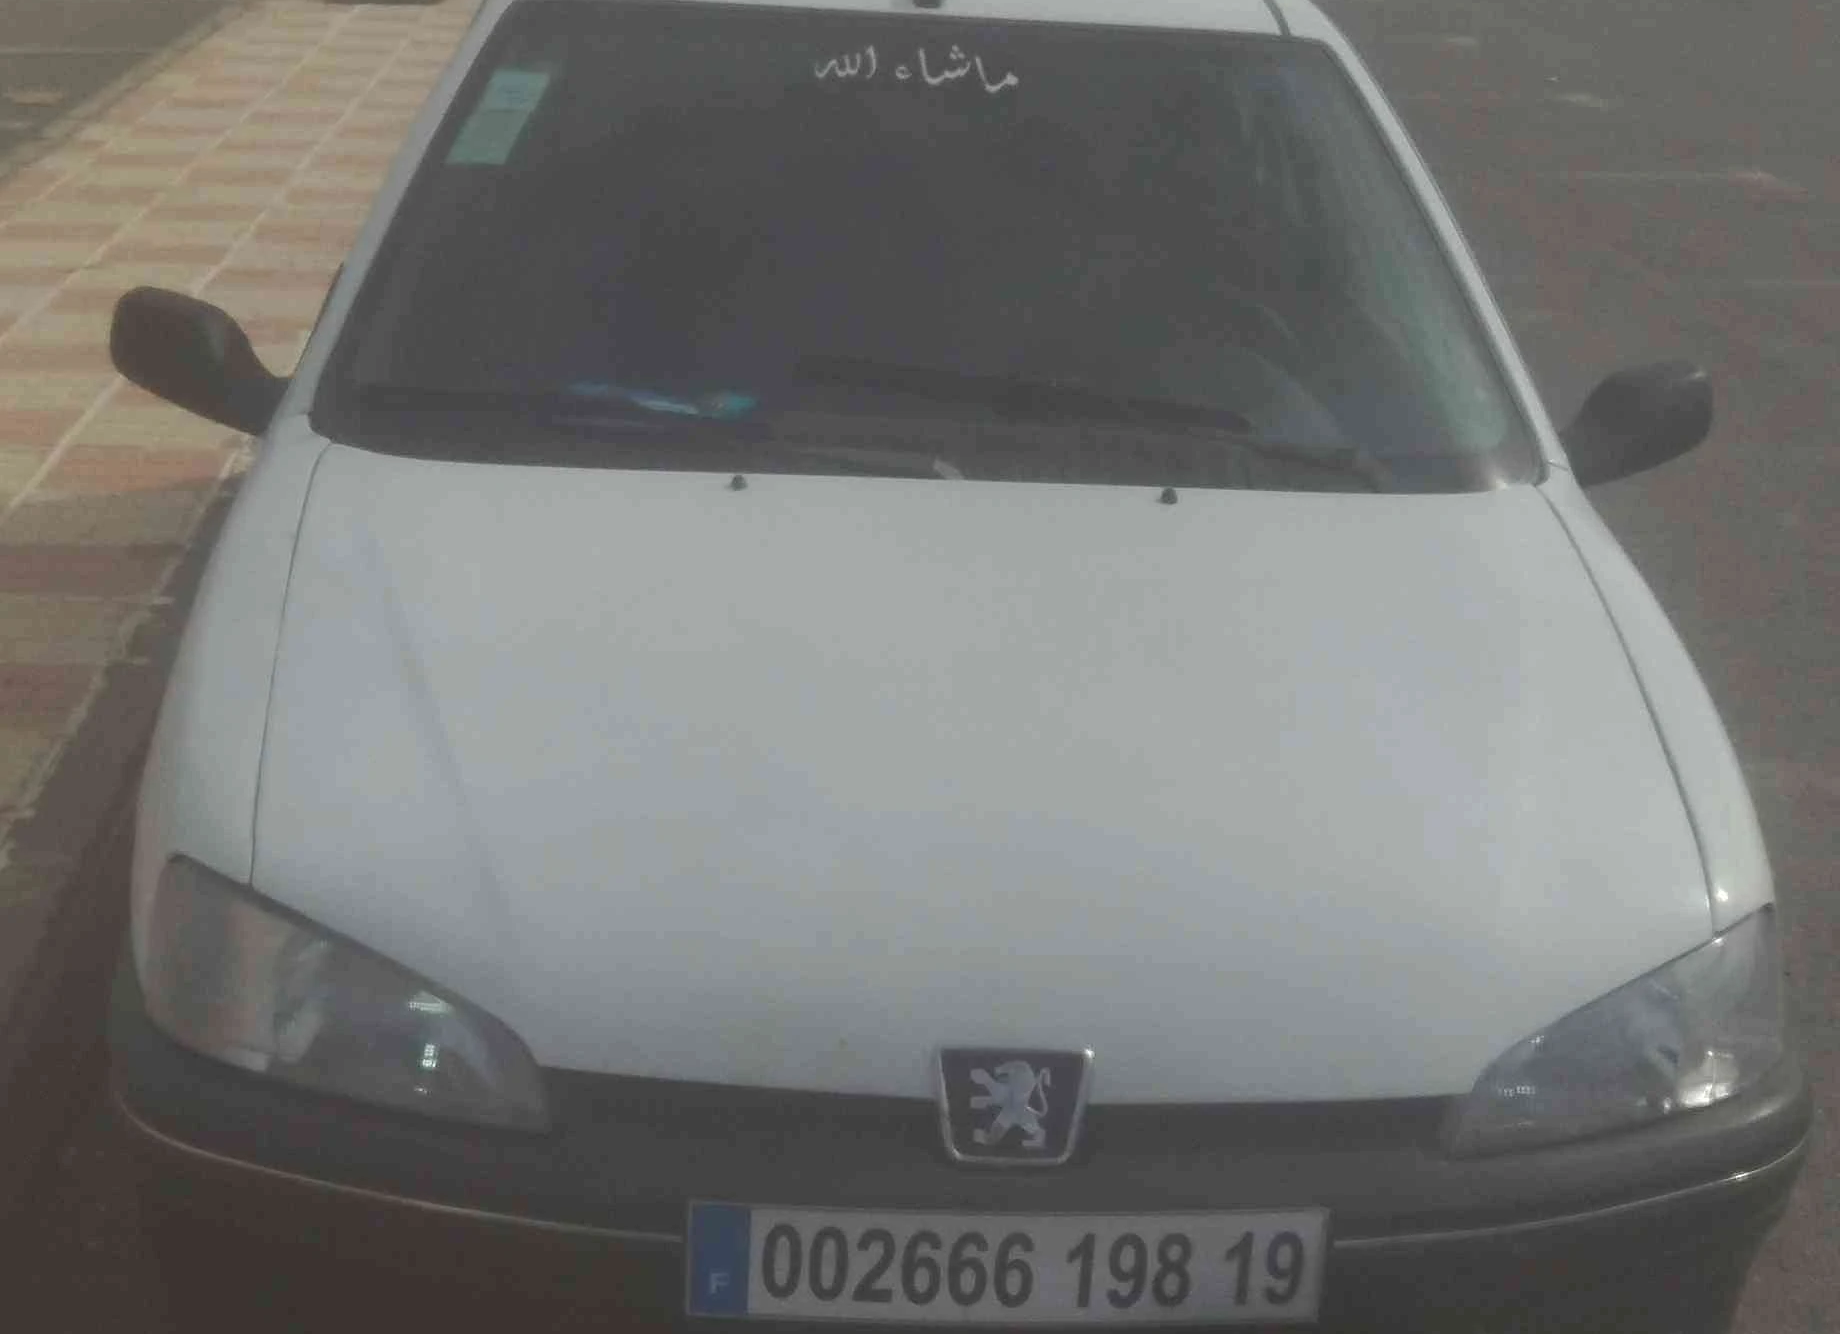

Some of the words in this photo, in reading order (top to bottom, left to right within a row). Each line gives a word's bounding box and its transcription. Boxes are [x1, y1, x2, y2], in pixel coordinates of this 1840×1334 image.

[814, 44, 877, 79] الله
[708, 1273, 729, 1296] F
[761, 1223, 1035, 1309] 002666
[1064, 1231, 1193, 1310] 198
[1223, 1230, 1306, 1307] 19
